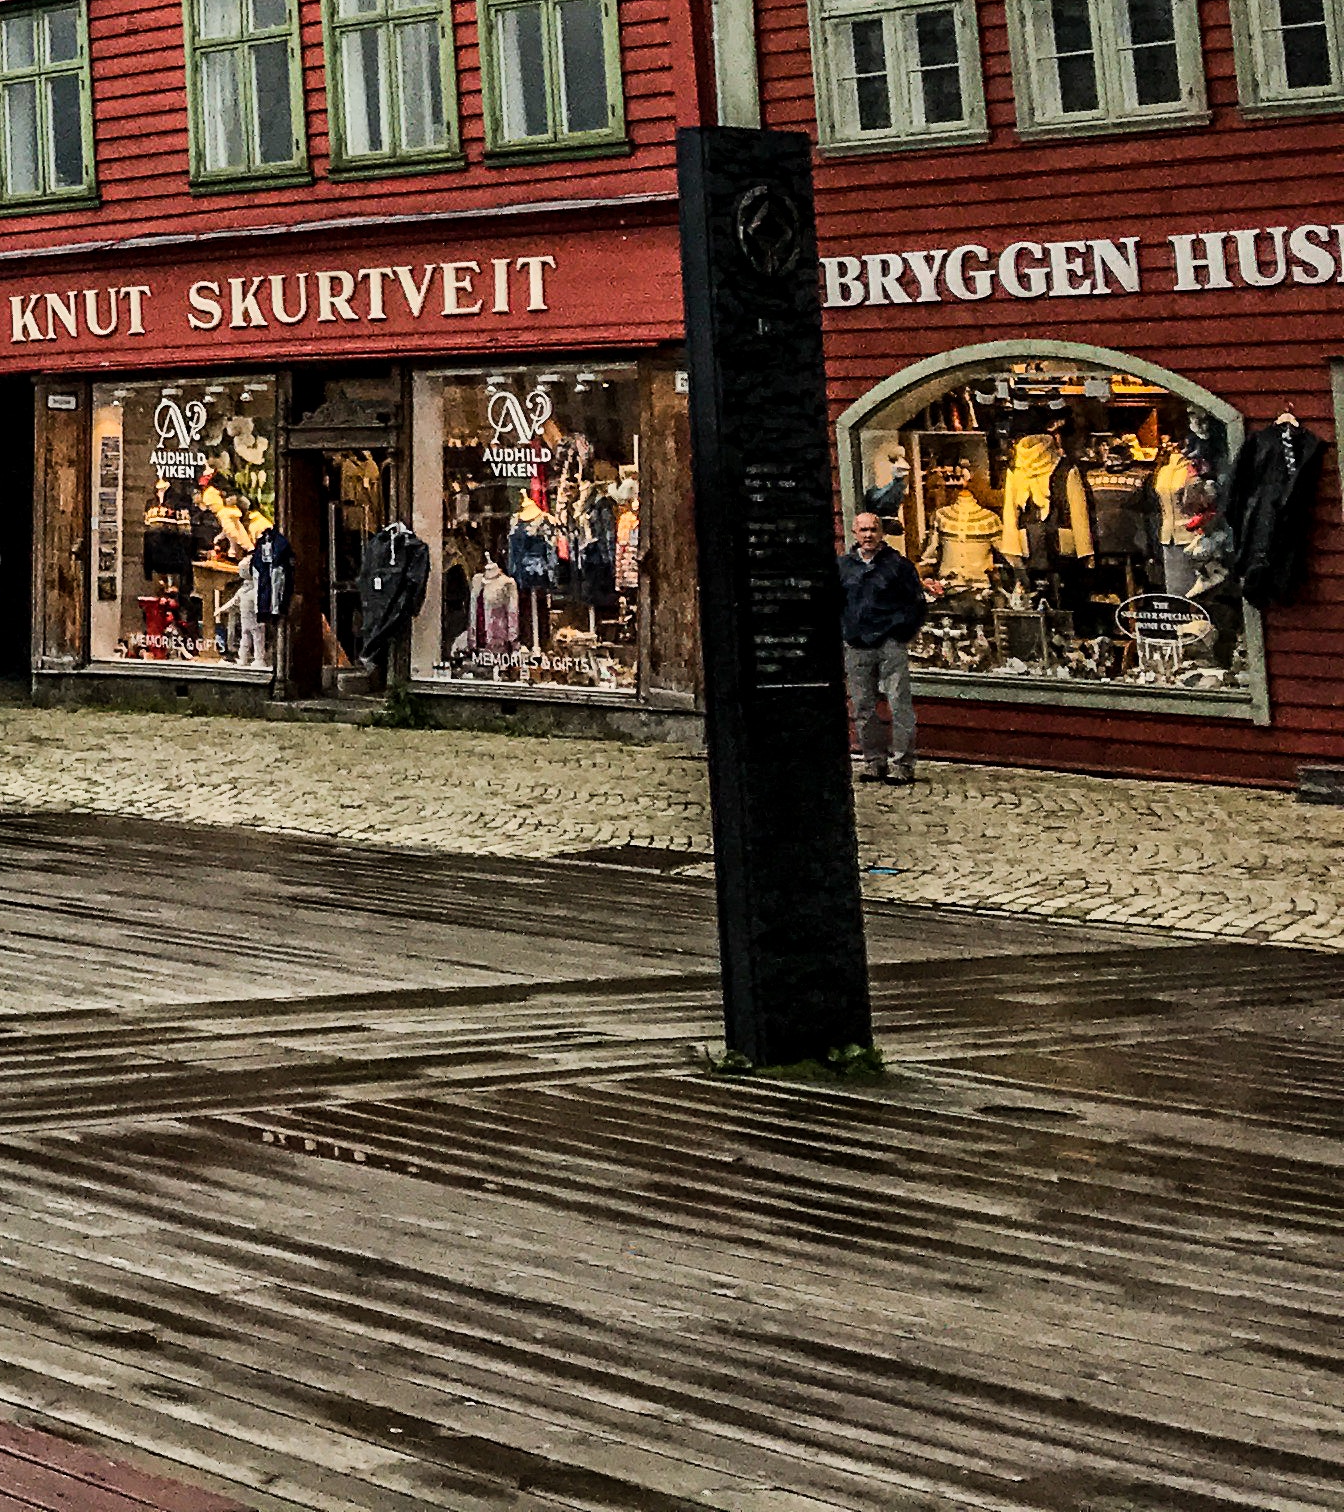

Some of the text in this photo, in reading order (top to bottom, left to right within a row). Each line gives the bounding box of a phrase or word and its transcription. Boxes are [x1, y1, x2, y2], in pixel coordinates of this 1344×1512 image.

[819, 235, 1142, 308] BRYGGEN
[9, 255, 557, 343] KNUT SKURTVEIT
[149, 451, 208, 466] AUDHILD
[483, 448, 552, 463] AUDHILD
[156, 464, 195, 479] VIKEN
[491, 462, 539, 477] VIKEN
[129, 632, 184, 650] MEMORIES
[471, 651, 539, 669] MEMORIES
[552, 655, 591, 673] GIFTS
